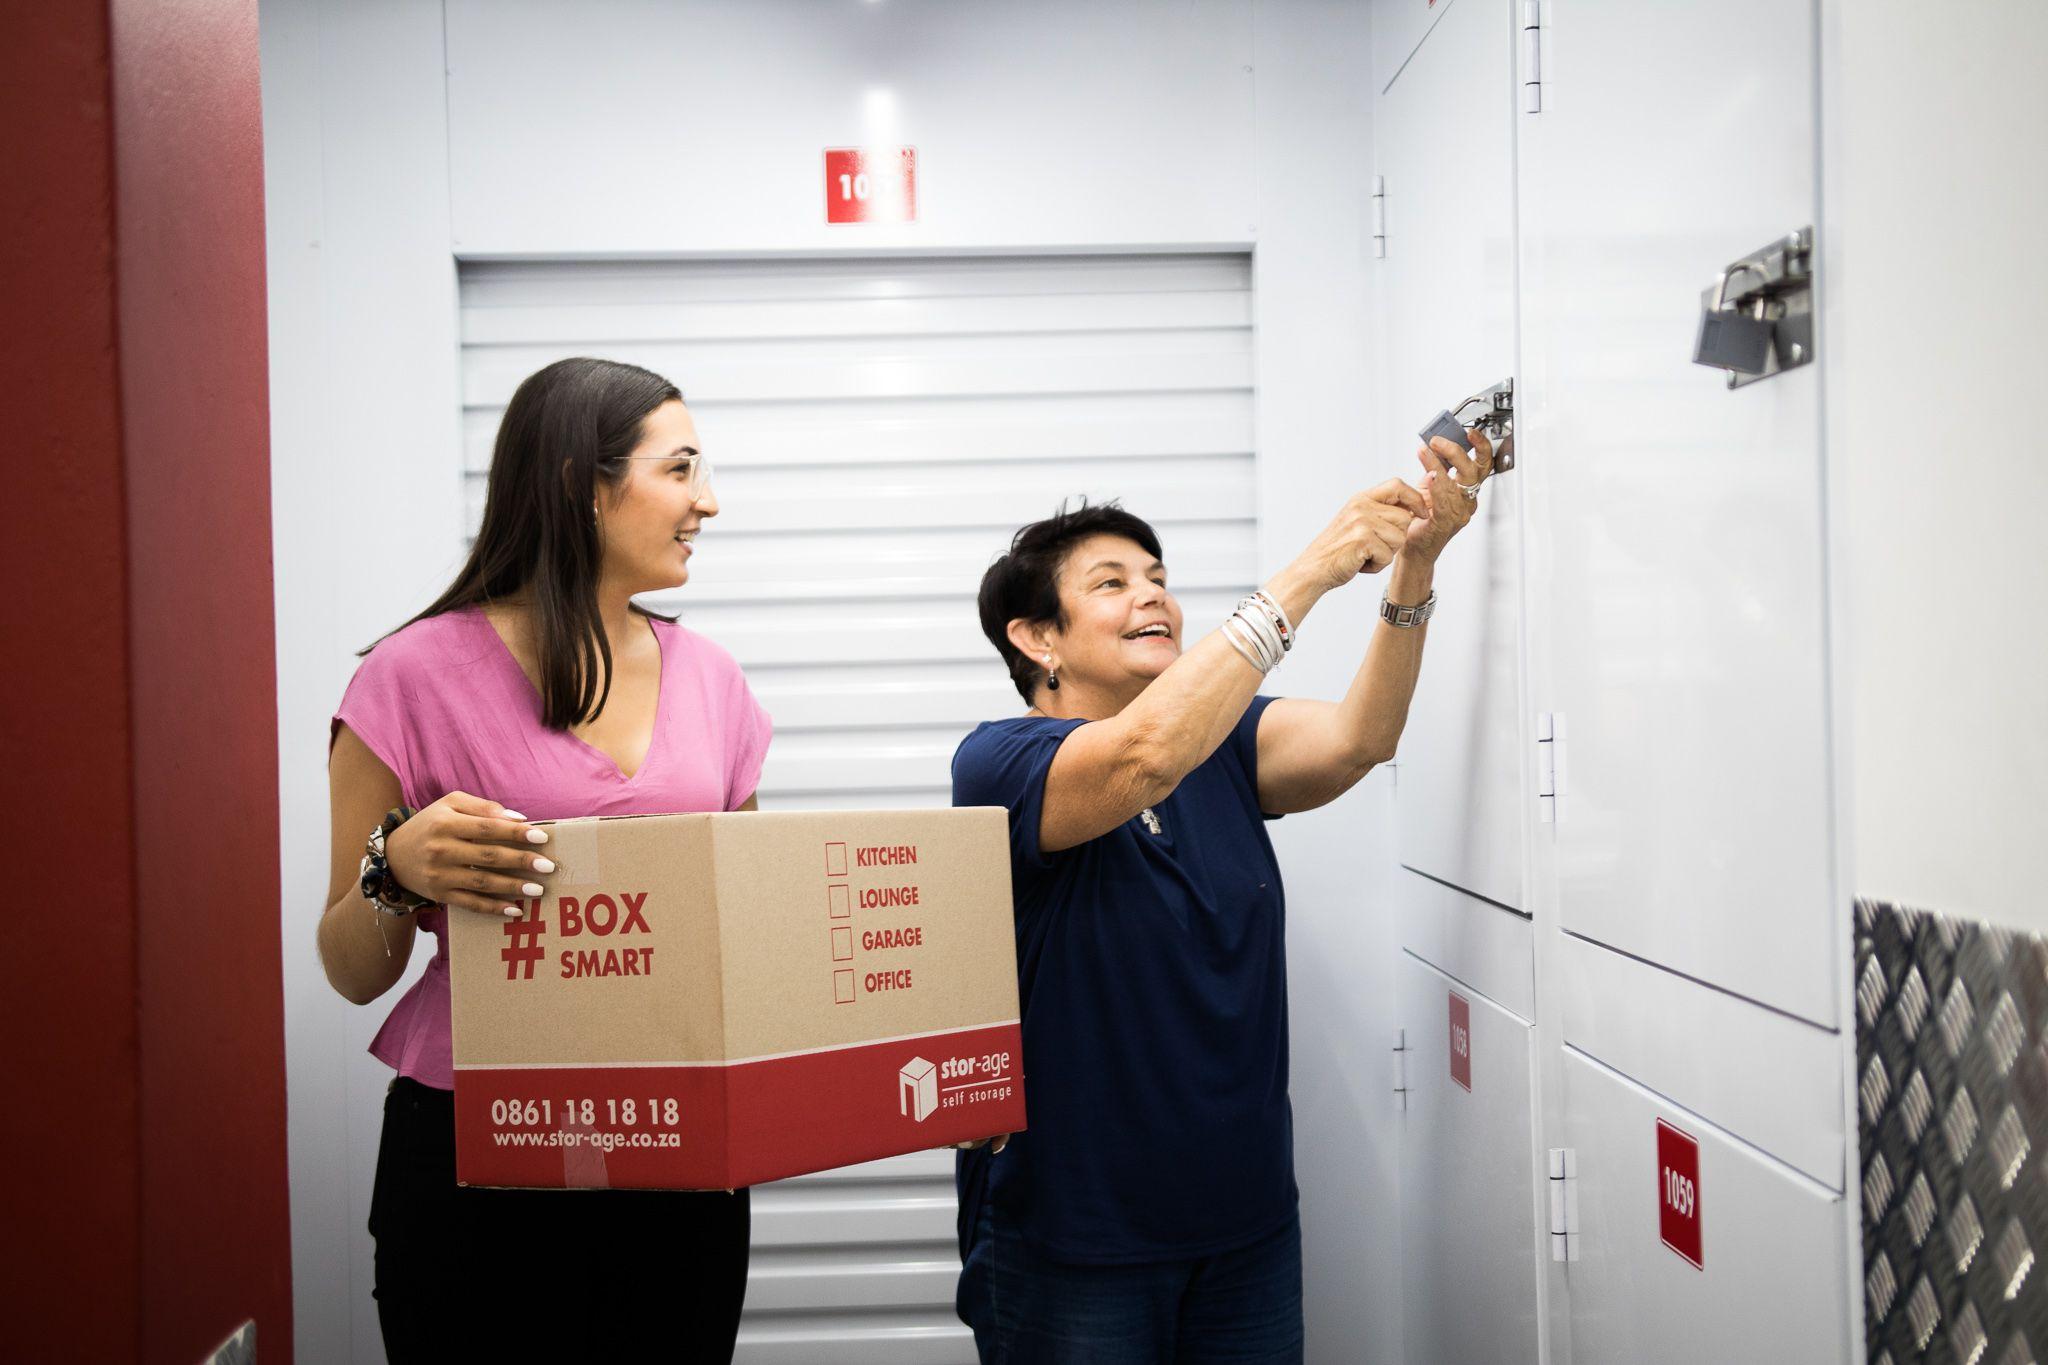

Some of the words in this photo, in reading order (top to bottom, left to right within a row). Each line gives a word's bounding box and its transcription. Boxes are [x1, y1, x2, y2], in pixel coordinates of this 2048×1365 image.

[856, 845, 918, 867] KITCHEN
[859, 886, 920, 909] LOUNGE
[558, 892, 652, 937] BOX
[862, 927, 922, 951] GARAGE
[560, 947, 655, 979] SMART
[864, 969, 912, 993] OFFICE
[941, 1052, 1010, 1080] stor-age
[943, 1091, 965, 1108] self
[969, 1086, 1012, 1104] storage
[491, 1098, 552, 1126] 0861
[566, 1098, 596, 1126] 18
[607, 1098, 637, 1126] 18
[648, 1097, 680, 1126] 18
[493, 1129, 681, 1153] www.stor-age.co.za
[1664, 1165, 1695, 1219] 1059
